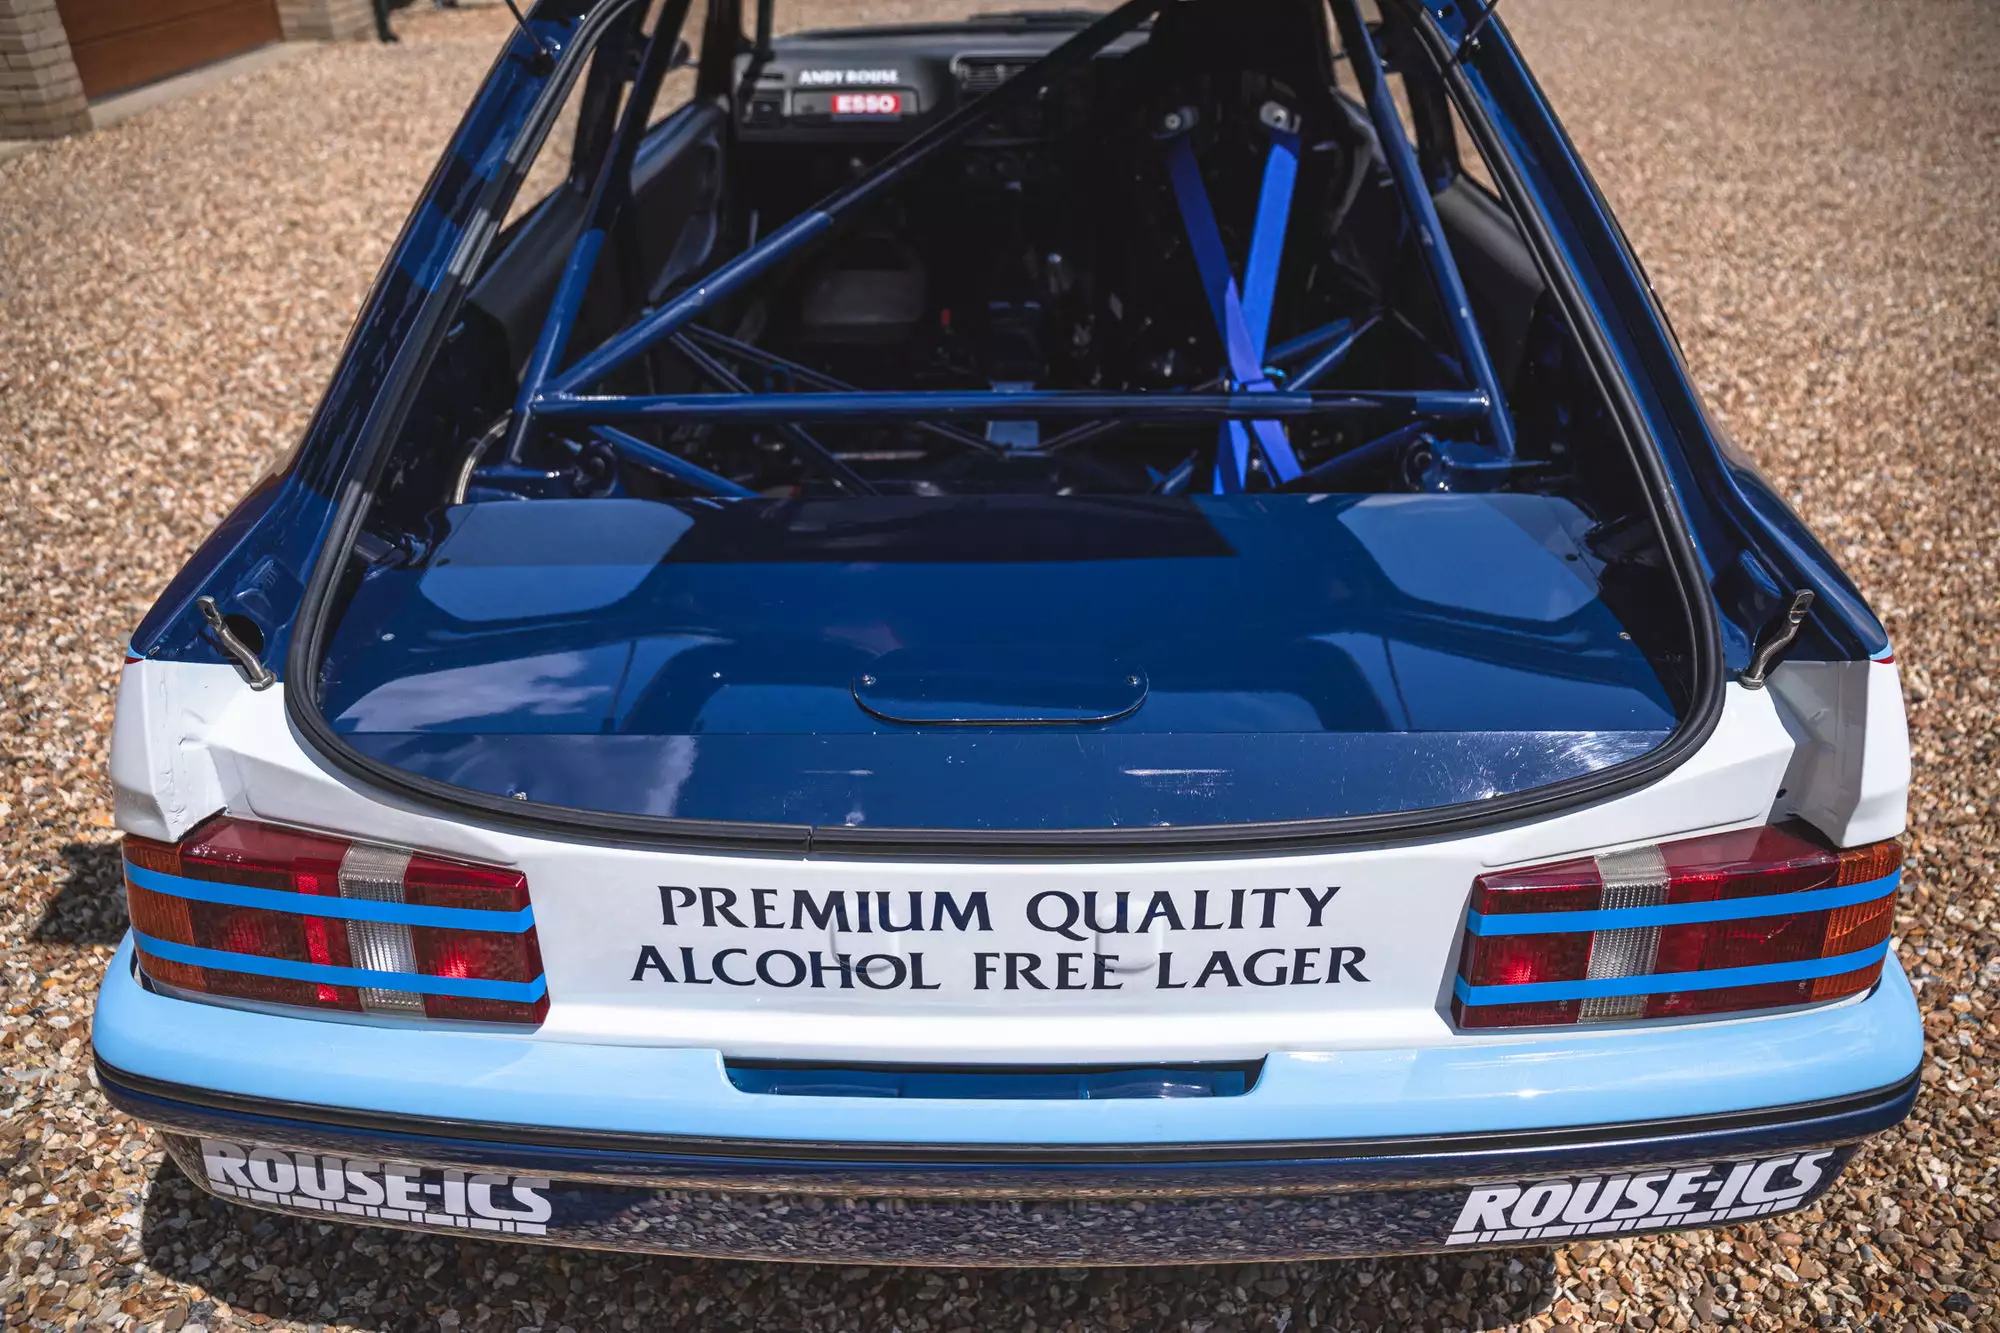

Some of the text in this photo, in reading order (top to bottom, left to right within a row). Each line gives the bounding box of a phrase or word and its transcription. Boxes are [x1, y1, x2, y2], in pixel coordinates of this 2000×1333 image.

[799, 70, 843, 85] ANDY
[836, 94, 896, 114] ESSO
[658, 885, 1341, 941] PREMIUM QUALITY
[630, 944, 1371, 990] ALCOHOL FREE LAGER
[201, 1138, 552, 1223] ROUSE-ICS
[1452, 1148, 1834, 1233] ROUSE-ICS
